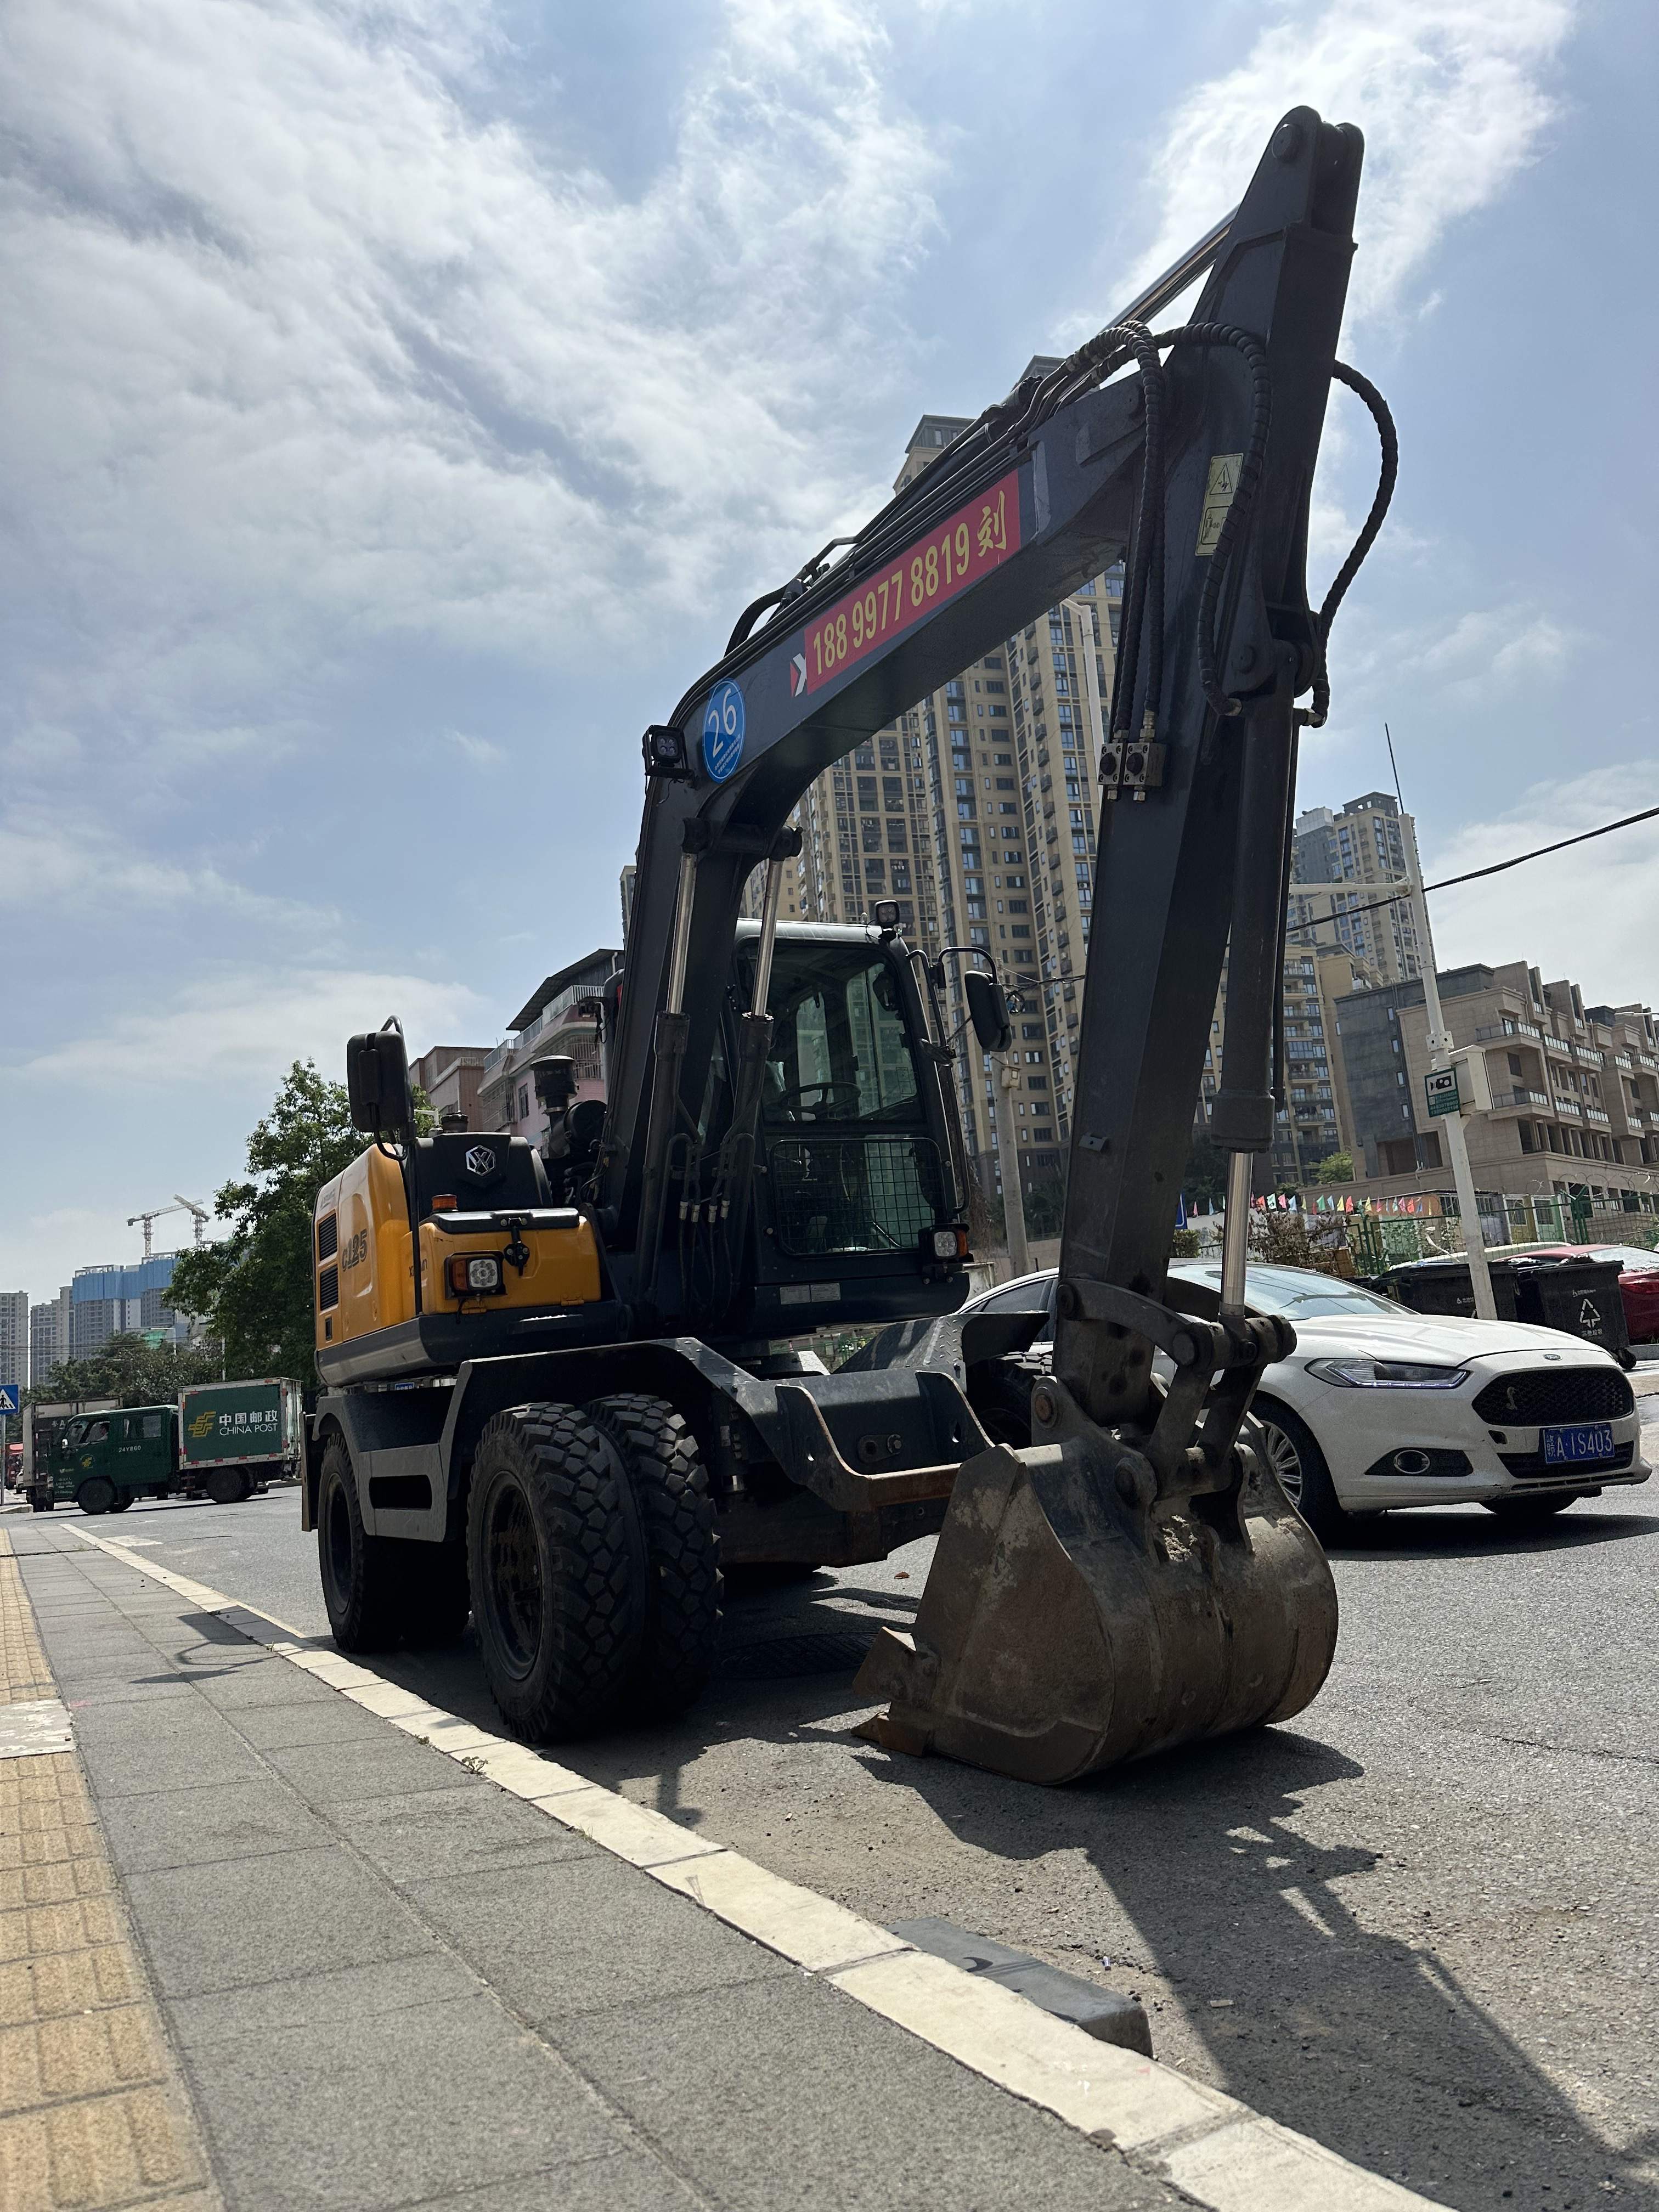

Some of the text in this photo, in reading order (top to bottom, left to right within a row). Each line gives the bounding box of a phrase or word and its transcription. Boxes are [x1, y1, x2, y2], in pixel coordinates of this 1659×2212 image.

[813, 613, 848, 675] 188
[852, 569, 903, 648] 9977
[910, 522, 970, 607] 8819
[708, 688, 737, 758] 26
[219, 1409, 278, 1426] 中国邮政
[219, 1423, 278, 1436] CHINA POST
